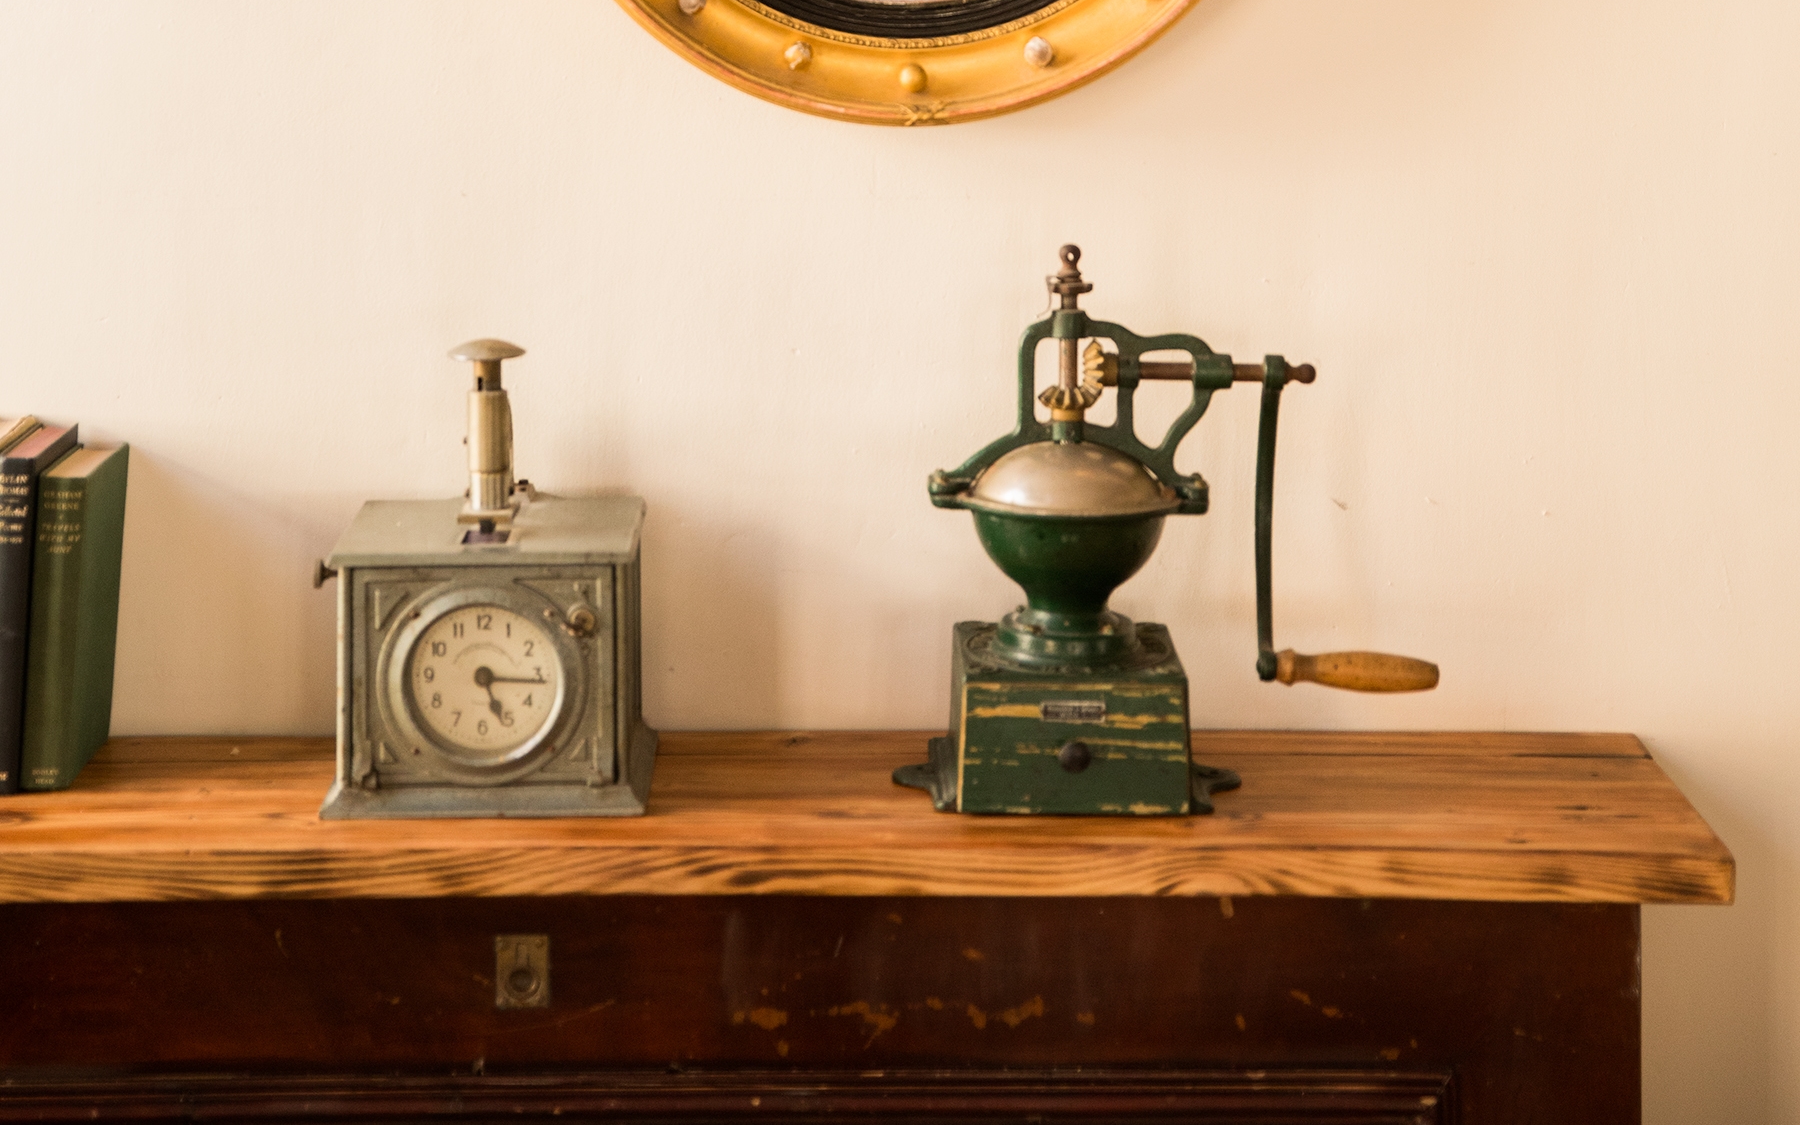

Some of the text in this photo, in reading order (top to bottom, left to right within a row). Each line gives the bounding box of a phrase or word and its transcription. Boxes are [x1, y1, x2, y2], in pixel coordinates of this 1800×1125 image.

[43, 502, 79, 510] GREENE
[453, 623, 464, 638] 11
[476, 614, 492, 631] 12
[507, 623, 511, 637] 1
[431, 641, 447, 657] 10
[523, 641, 534, 657] 2
[423, 667, 435, 683] 9
[533, 667, 544, 683] 3
[431, 693, 442, 709] 8
[523, 693, 533, 708] 4
[451, 711, 462, 727] 7
[503, 711, 514, 727] 5
[477, 720, 488, 736] 6
